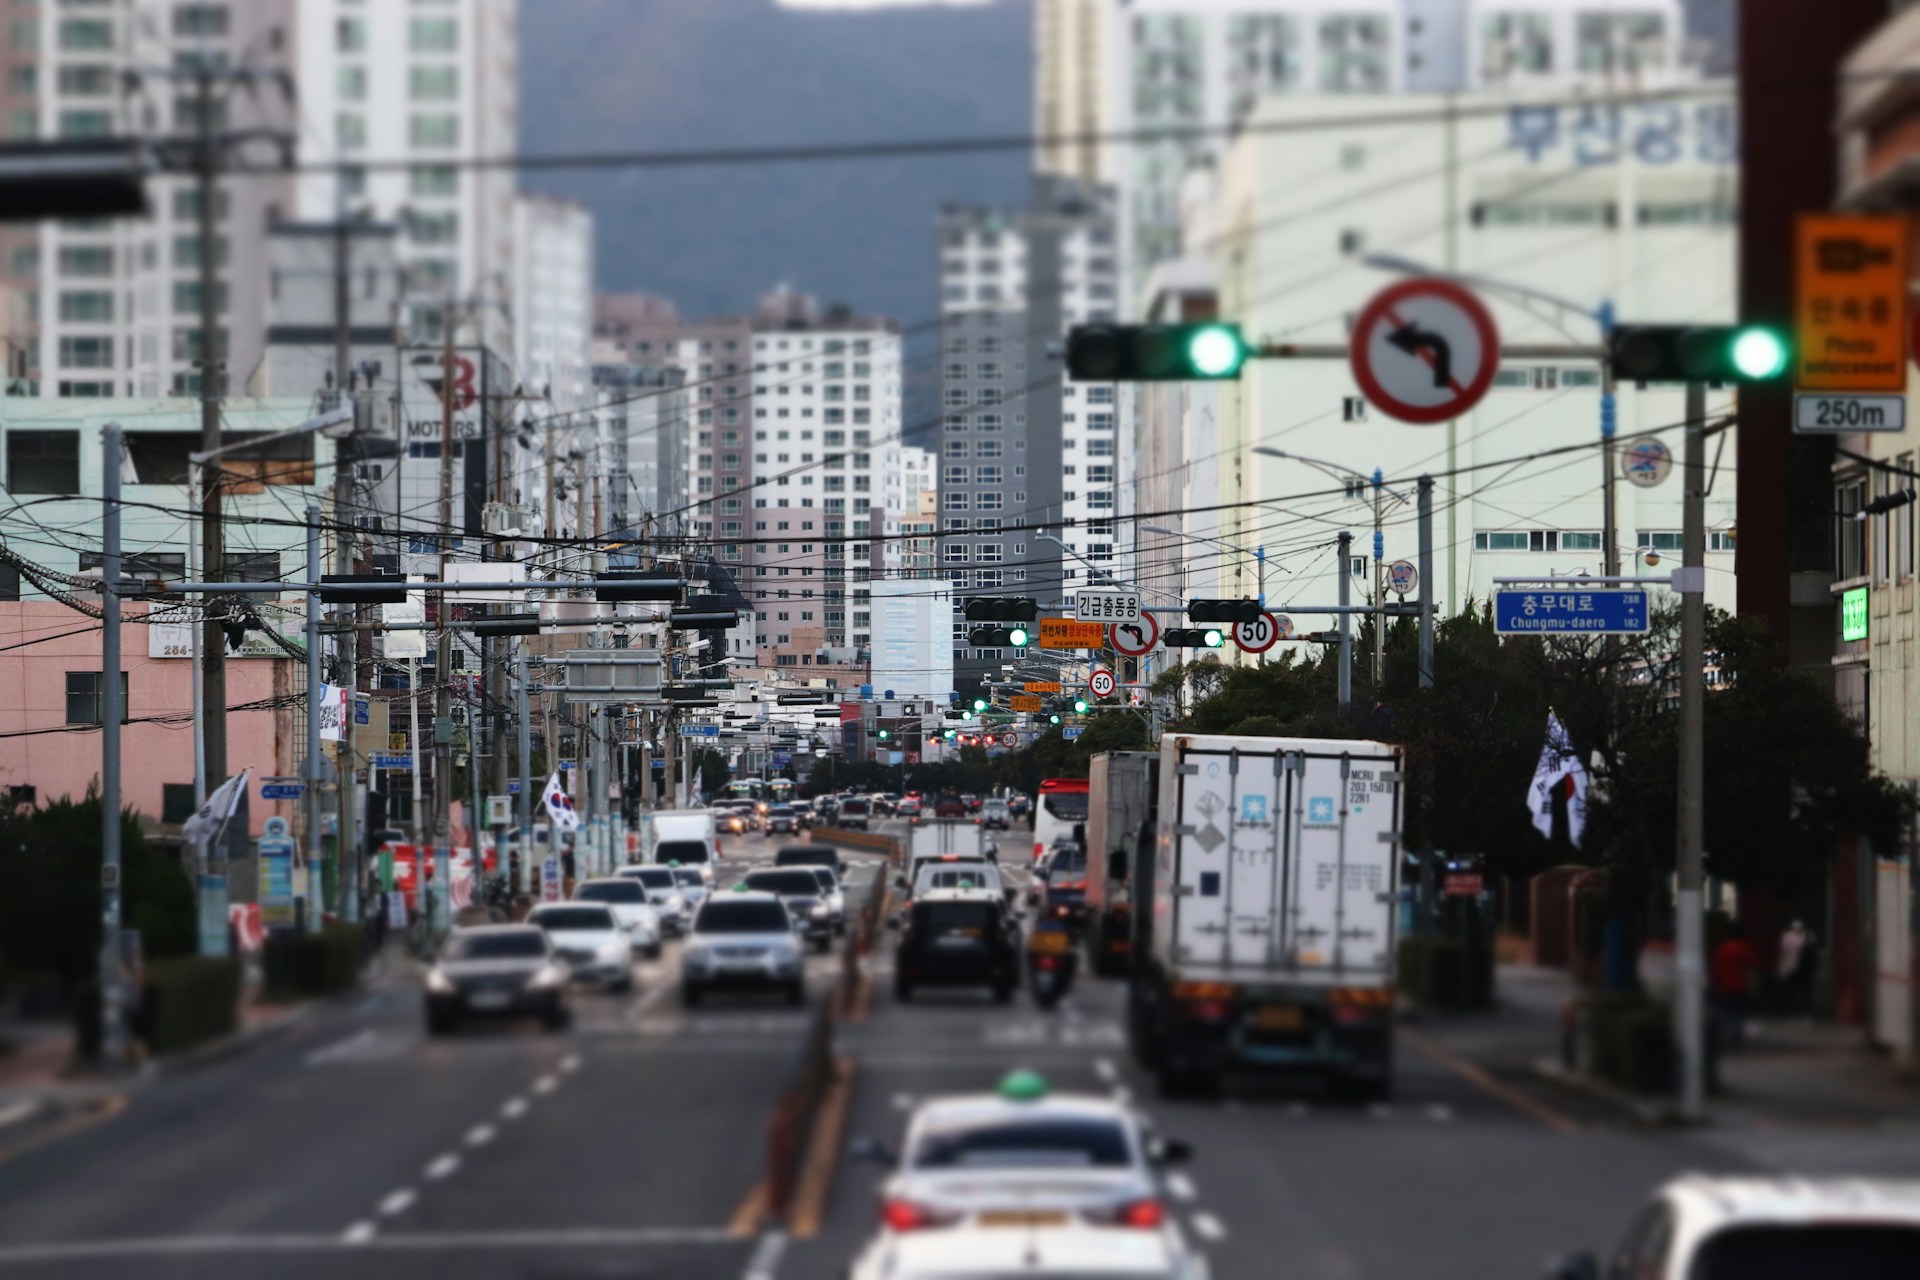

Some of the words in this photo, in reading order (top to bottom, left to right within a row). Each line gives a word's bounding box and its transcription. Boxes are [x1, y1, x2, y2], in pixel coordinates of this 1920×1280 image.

[1825, 336, 1877, 354] Photo
[1804, 360, 1896, 375] enforcement
[1815, 401, 1885, 425] 250m
[407, 421, 475, 438] MOTRS
[1079, 596, 1137, 617] 긴급출동용
[1521, 594, 1594, 616] 충무대로
[1242, 620, 1267, 641] 50
[1510, 616, 1605, 630] Chungmu-daero
[1623, 618, 1639, 628] 182
[1095, 677, 1110, 690] 50
[1351, 769, 1374, 781] MCRU
[1350, 781, 1366, 792] 203
[1369, 782, 1384, 793] 150
[1349, 793, 1370, 803] 22R1
